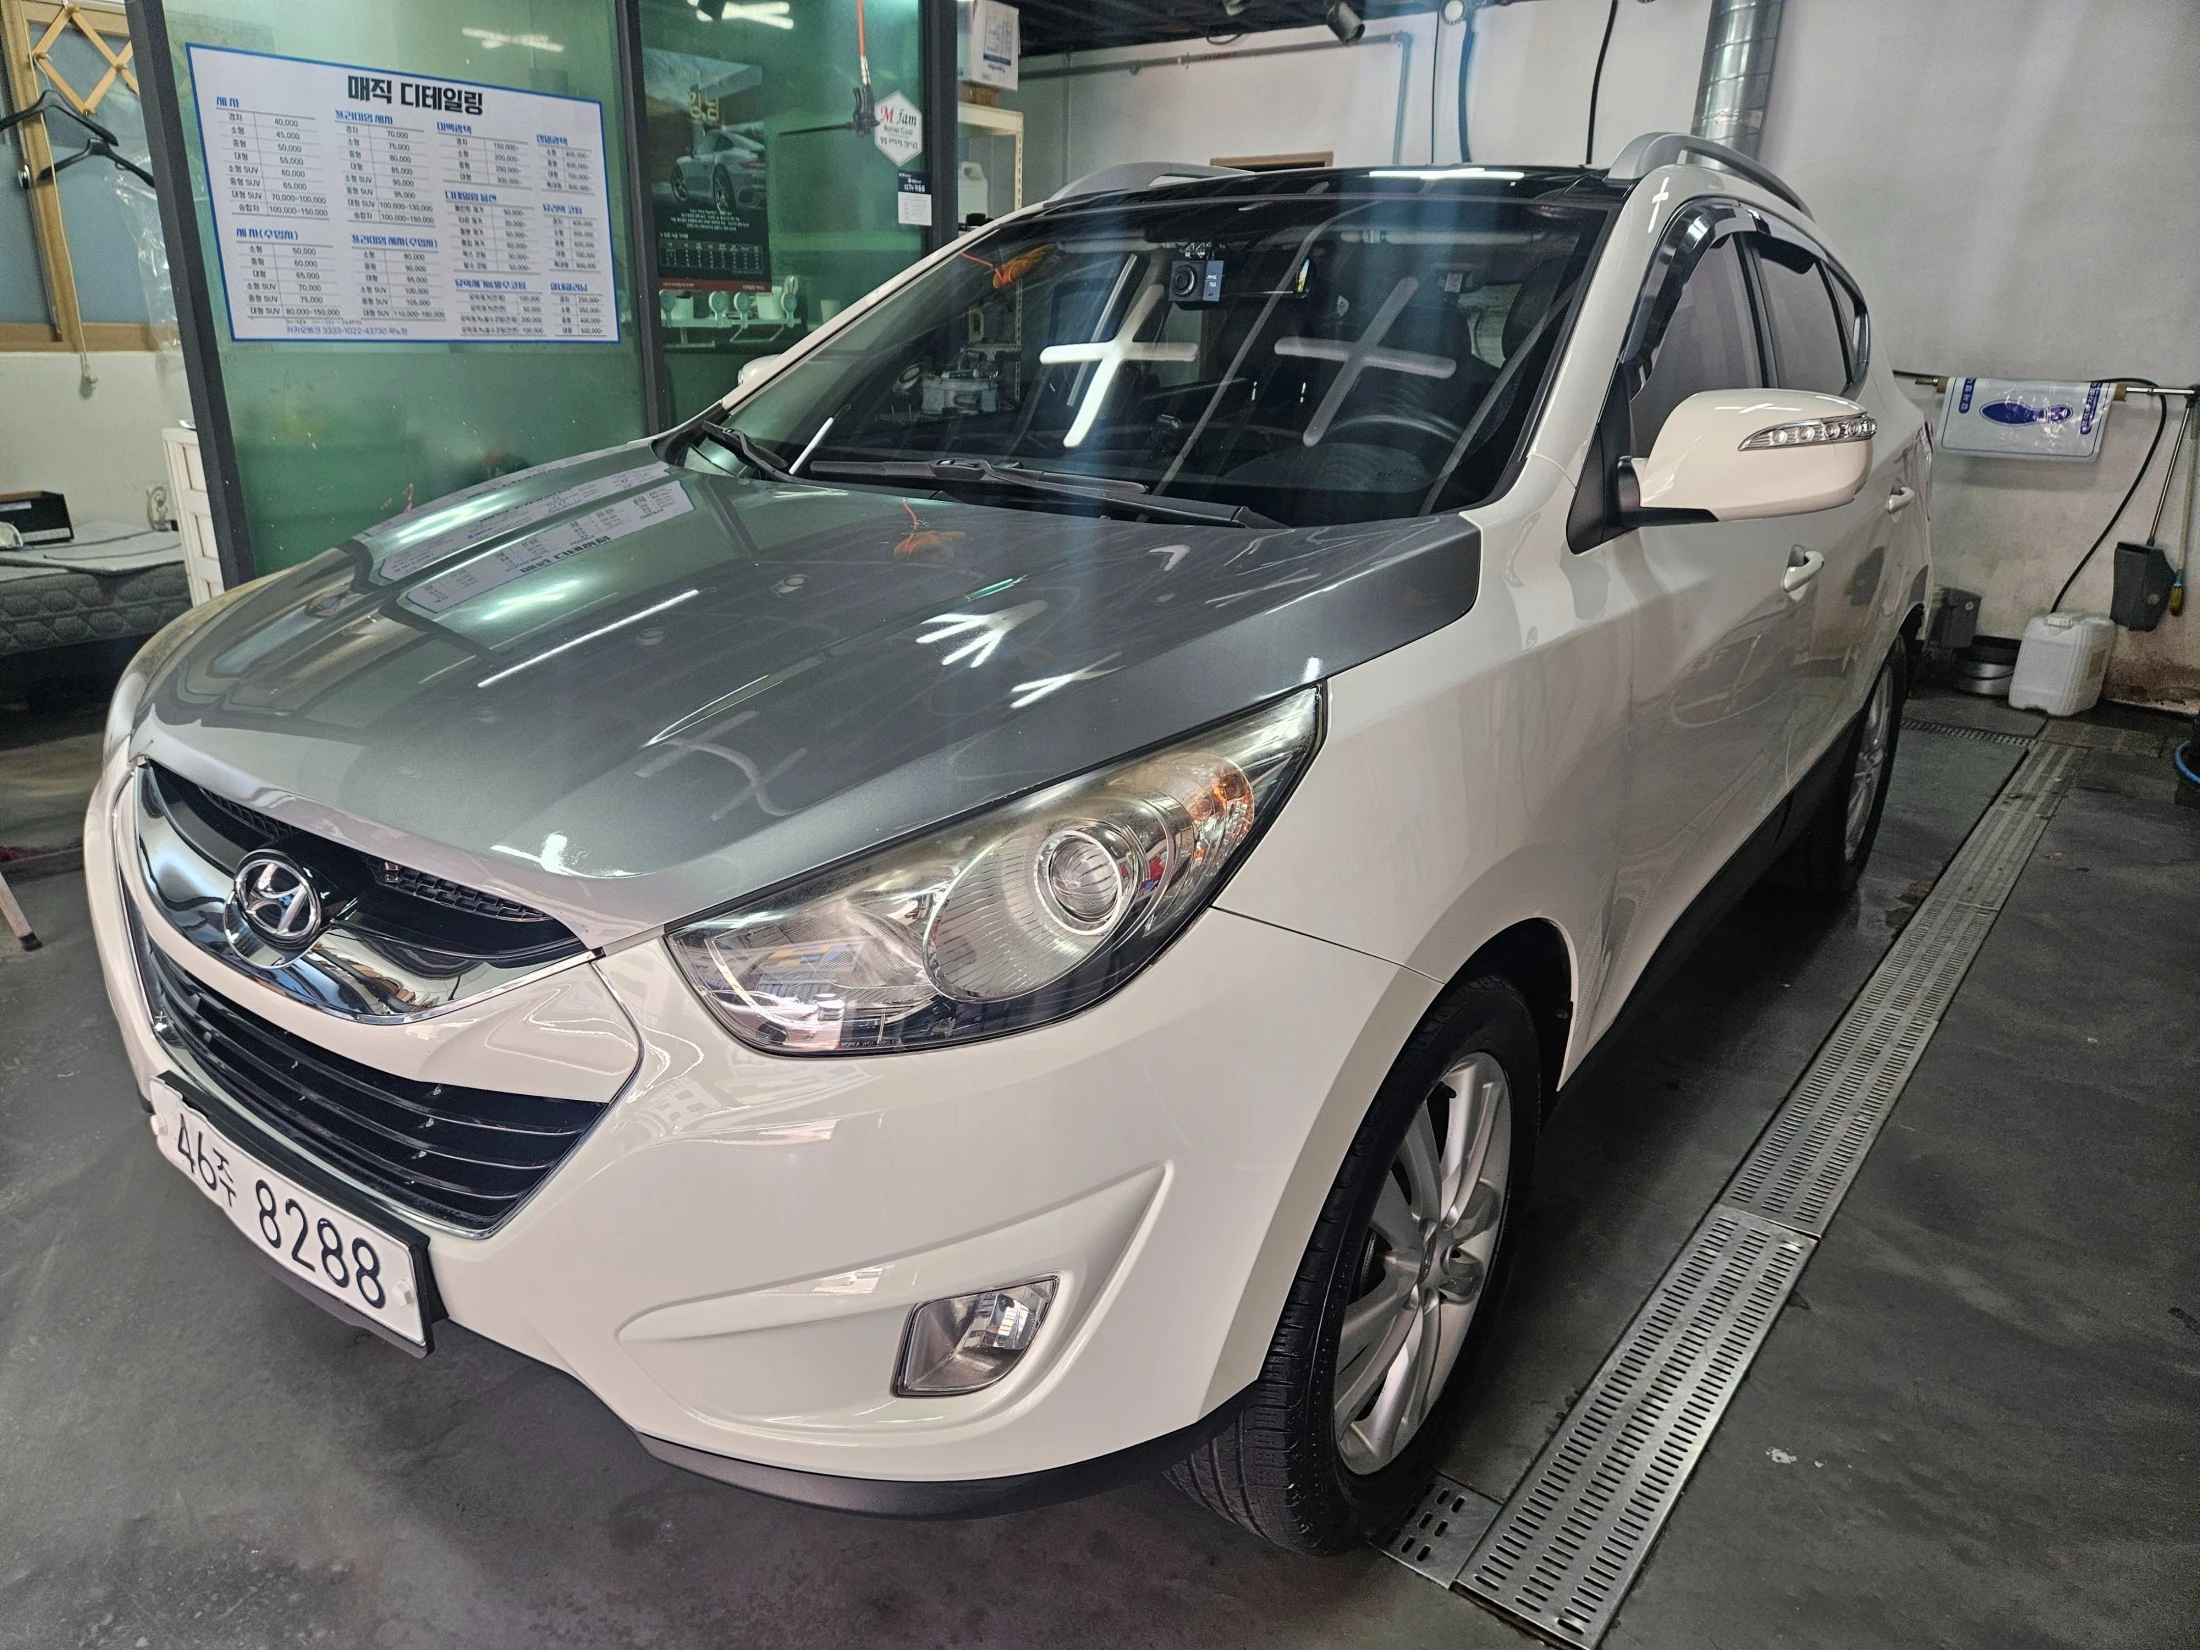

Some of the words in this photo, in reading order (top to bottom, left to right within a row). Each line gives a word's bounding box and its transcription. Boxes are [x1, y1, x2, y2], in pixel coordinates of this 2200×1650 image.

[348, 75, 392, 104] 매직
[400, 82, 483, 116] 디테일링
[229, 113, 242, 121] 경차
[275, 119, 298, 127] 40,000
[335, 109, 373, 122] 프리미엄
[375, 115, 393, 125] 세차
[897, 108, 916, 126] fam
[232, 126, 244, 135] 소형
[276, 132, 300, 140] 45,000
[387, 130, 408, 139] 70,000
[233, 139, 246, 148] 중형
[278, 144, 302, 153] 50,000
[389, 143, 410, 151] 75,000
[234, 152, 248, 161] 대형
[280, 156, 303, 165] 55,000
[390, 154, 411, 163] 80,000
[229, 164, 241, 173] 소형
[281, 169, 305, 178] 60,000
[350, 162, 363, 171] 대형
[391, 167, 413, 175] 85,000
[230, 177, 243, 186] 중형
[283, 182, 307, 190] 65,000
[393, 179, 414, 187] 90,000
[232, 190, 245, 199] 대형
[360, 188, 373, 196] SUV
[445, 190, 479, 202] 디테일링
[239, 203, 259, 212] 승합차
[250, 245, 262, 253] 소형
[252, 258, 264, 266] 중형
[294, 260, 318, 268] 60,000
[253, 270, 266, 278] 대형
[296, 272, 320, 280] 65,000
[247, 282, 260, 291] 소형
[262, 283, 276, 291] SUV
[299, 284, 321, 292] 70,000
[249, 294, 262, 303] 중형
[301, 296, 323, 304] 75,000
[250, 307, 264, 315] 대형
[176, 1112, 237, 1209] 46주
[255, 1179, 386, 1310] 8288
